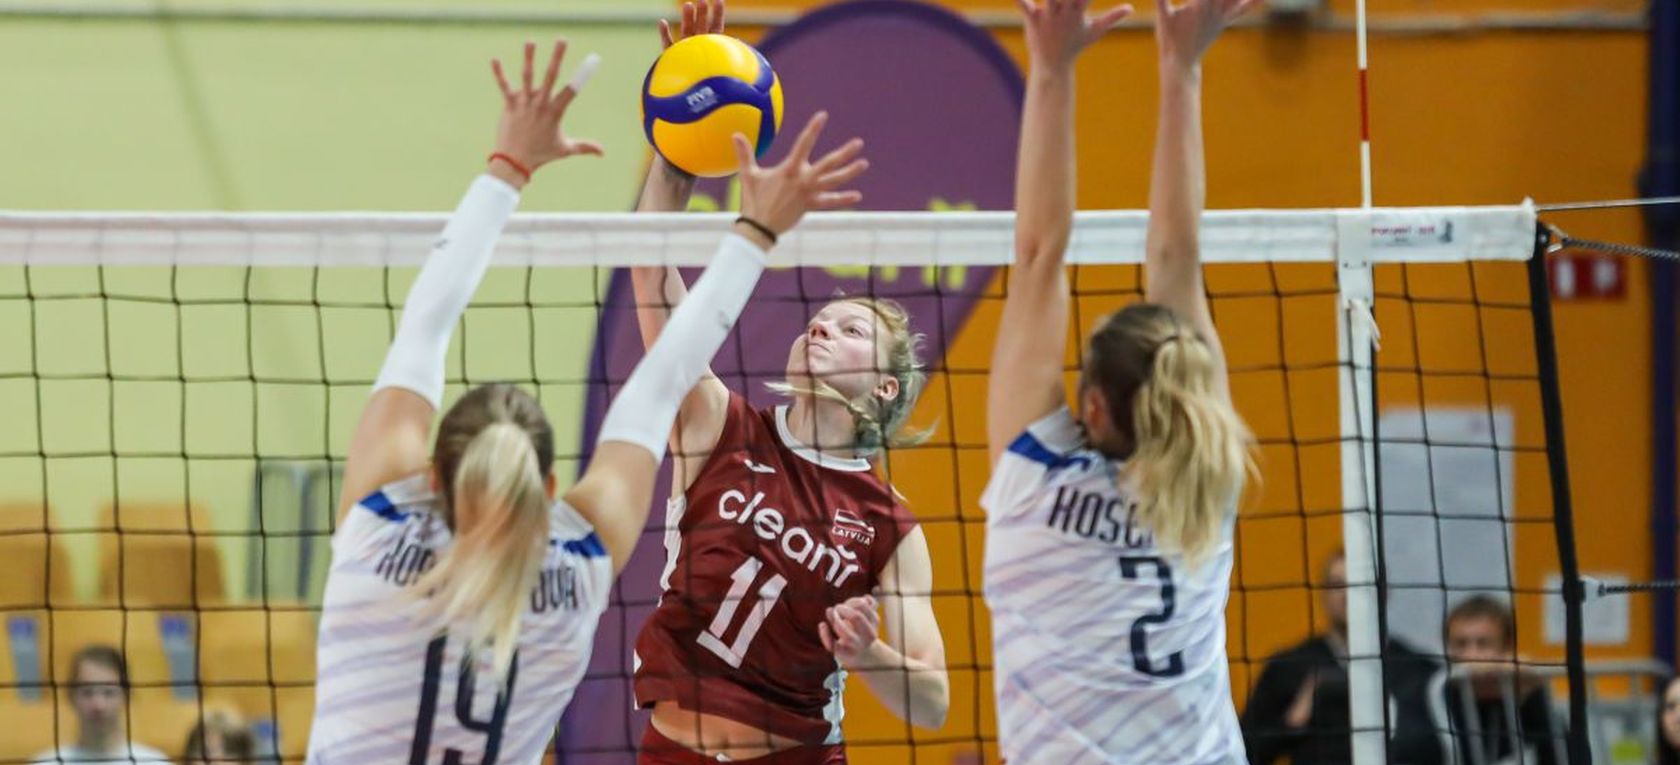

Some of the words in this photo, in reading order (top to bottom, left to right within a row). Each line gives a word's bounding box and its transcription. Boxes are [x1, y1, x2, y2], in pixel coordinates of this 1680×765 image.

[831, 526, 871, 546] LATVIJA
[696, 556, 788, 669] 11
[1119, 556, 1185, 677] 2
[409, 626, 520, 765] 19
